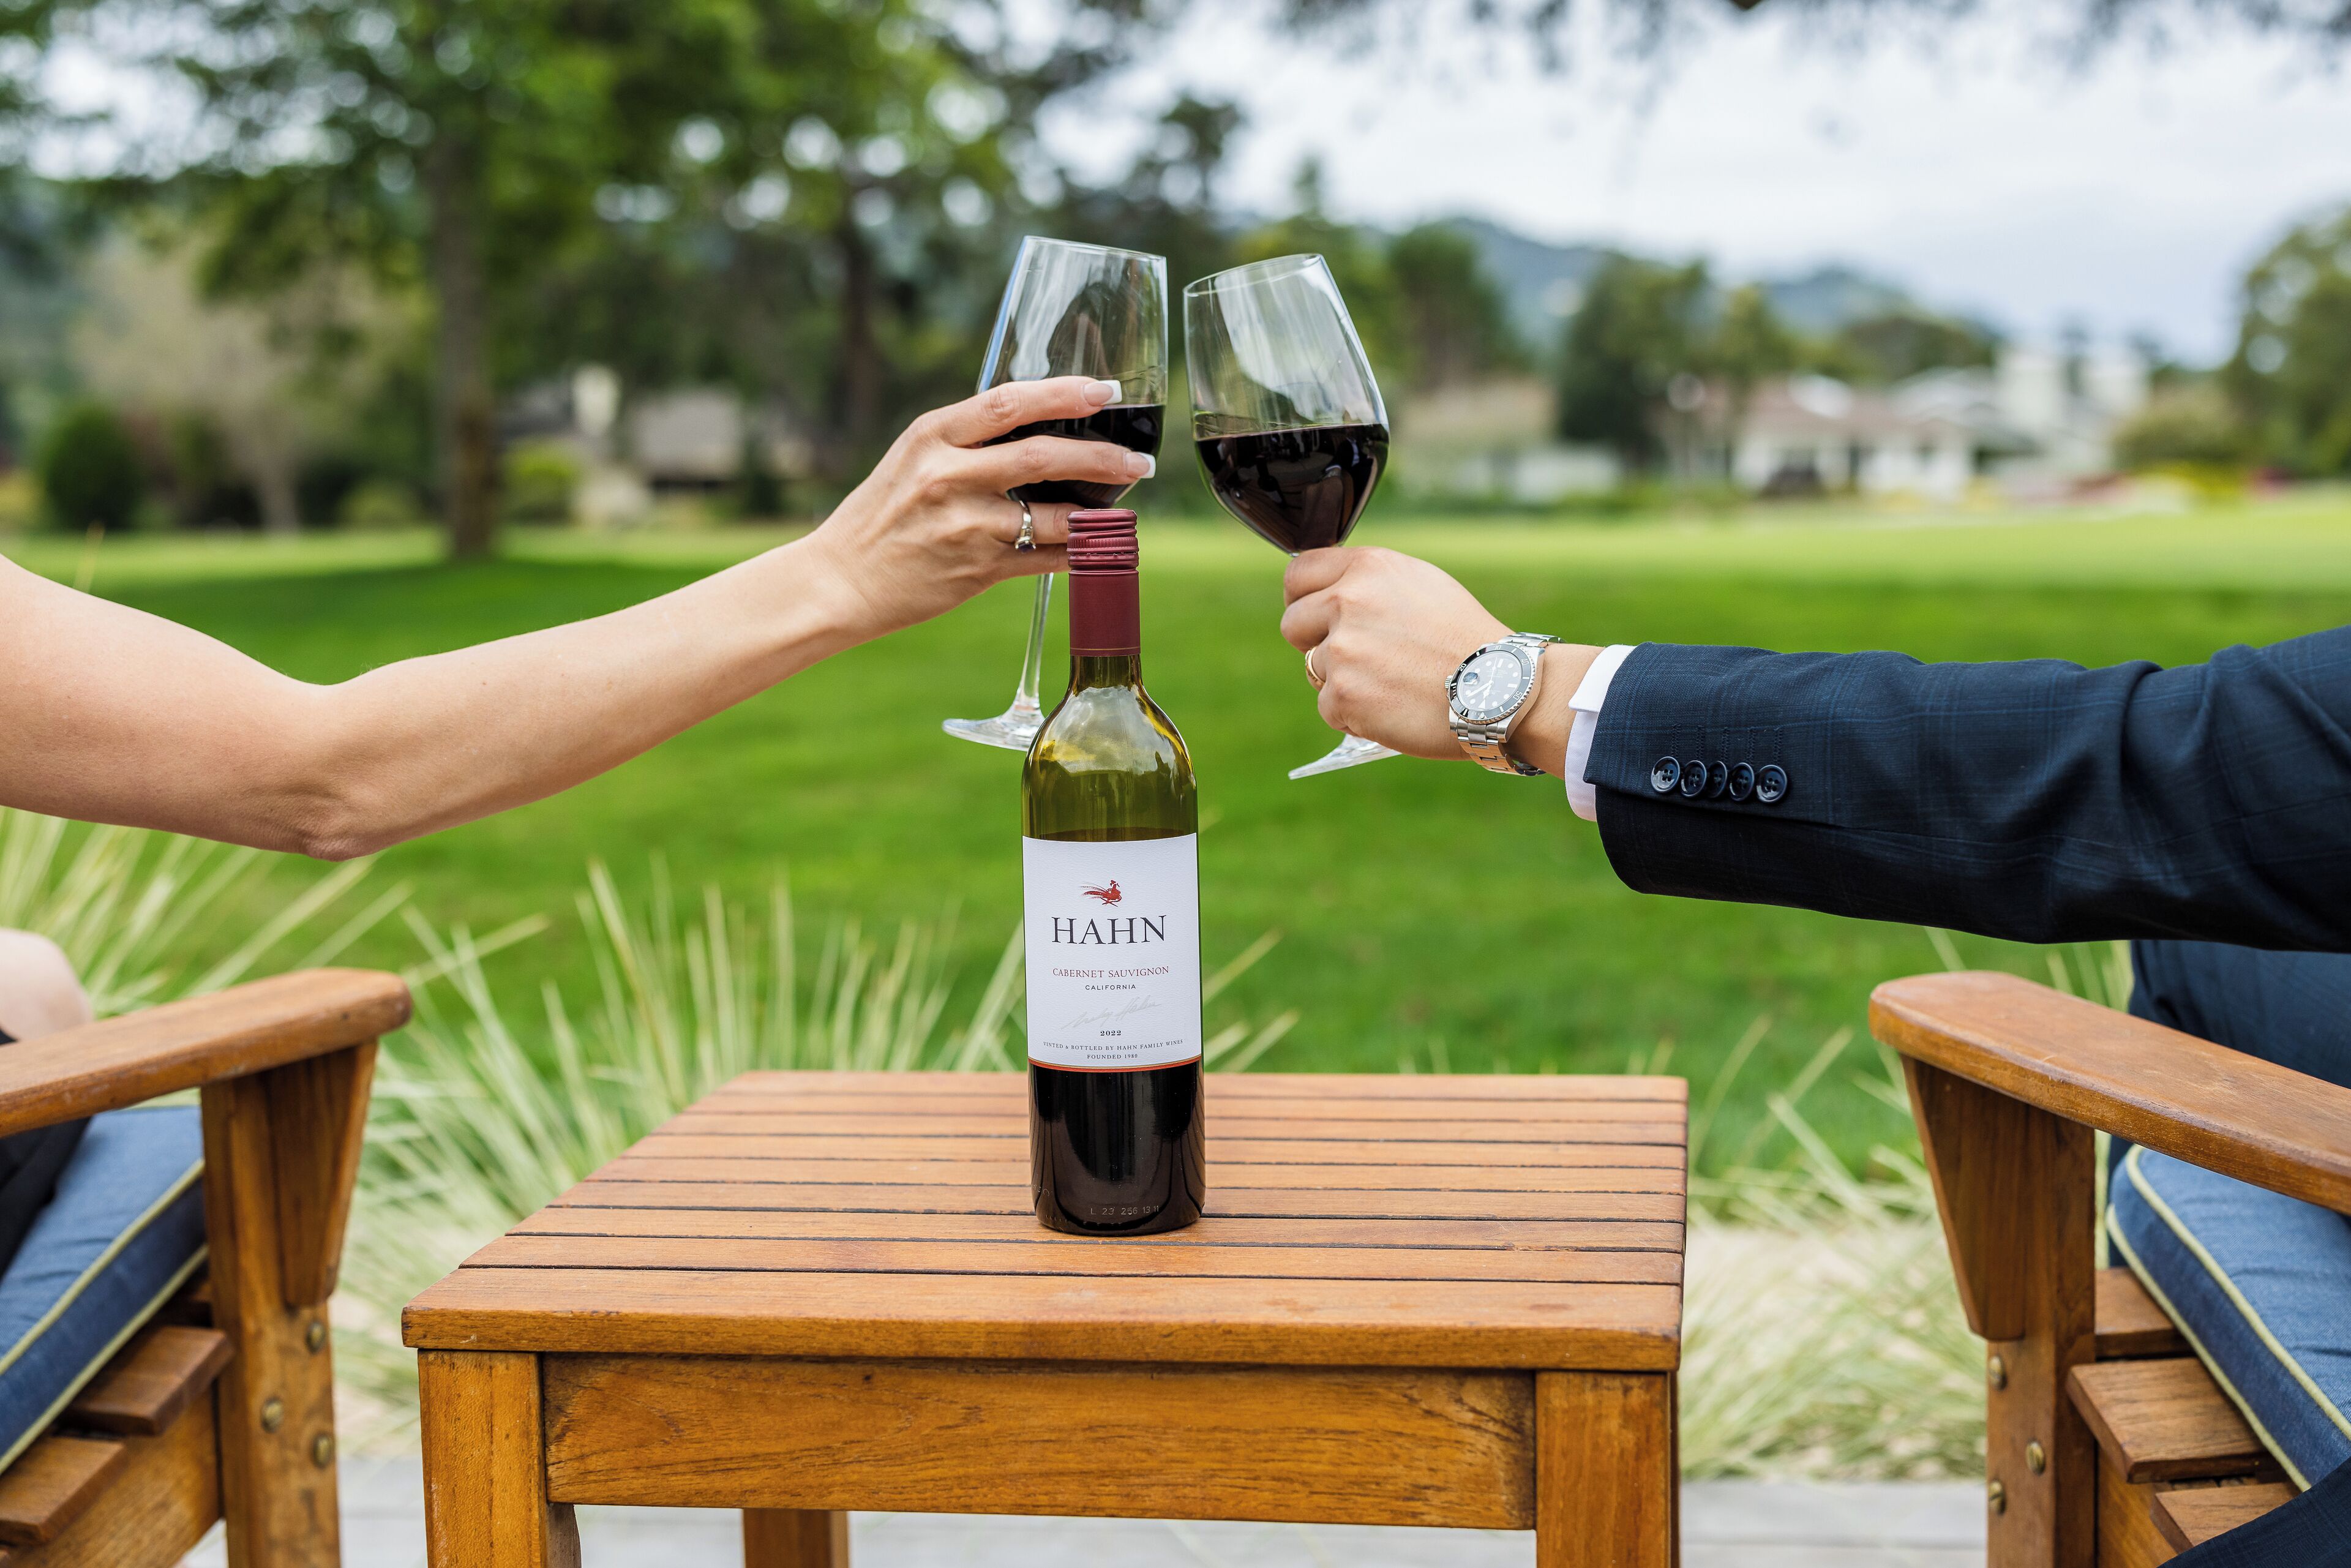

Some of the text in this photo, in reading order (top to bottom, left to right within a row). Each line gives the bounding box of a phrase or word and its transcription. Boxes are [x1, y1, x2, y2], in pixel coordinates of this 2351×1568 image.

[1458, 663, 1467, 672] 20
[1512, 690, 1523, 700] 50
[1051, 915, 1167, 945] HAHN
[1052, 966, 1169, 978] CABERNET SAUVIGNON
